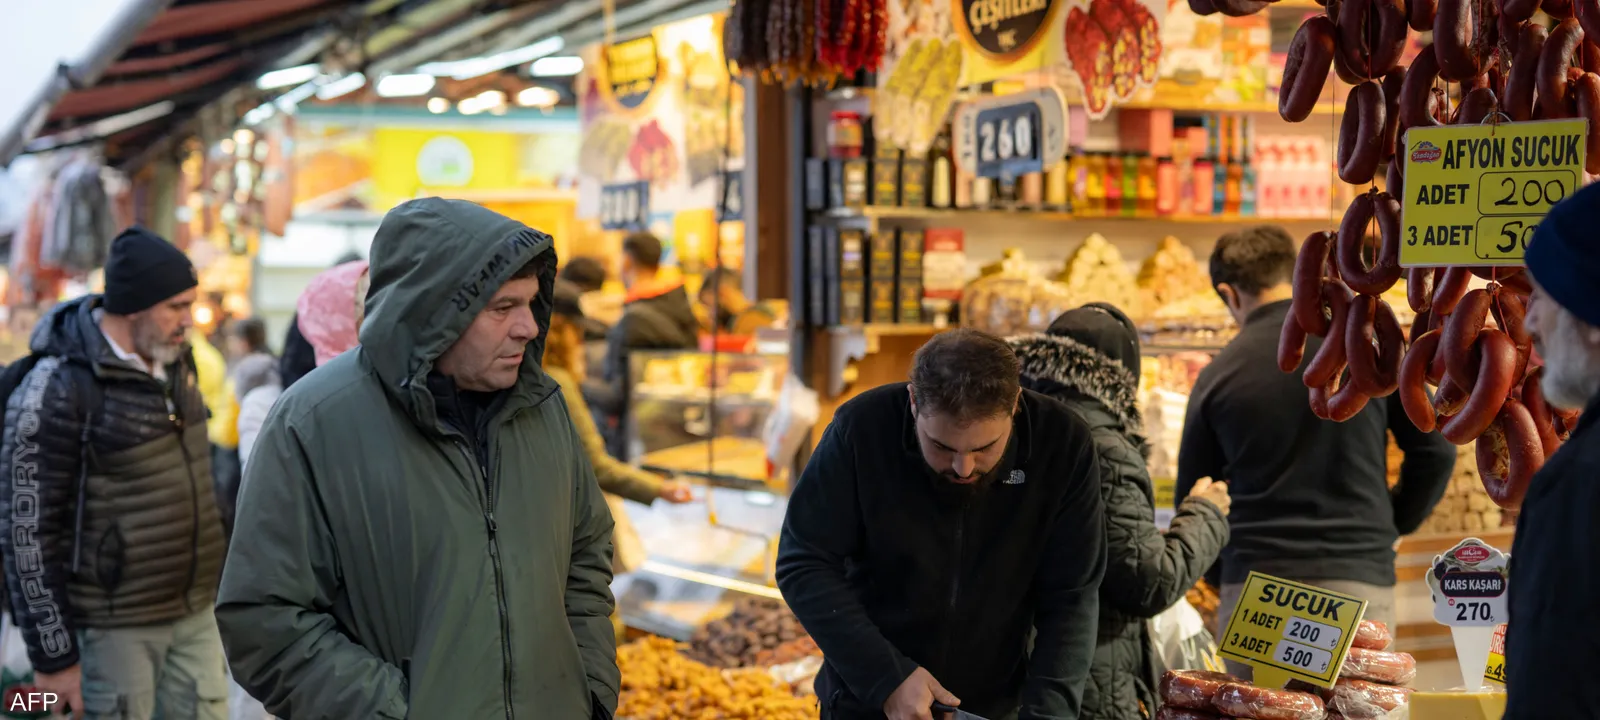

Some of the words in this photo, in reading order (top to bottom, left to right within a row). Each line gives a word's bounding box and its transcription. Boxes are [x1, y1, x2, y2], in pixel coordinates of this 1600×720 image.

[980, 116, 1031, 162] 260
[1442, 138, 1505, 169] AFYON
[1511, 134, 1581, 167] SUCUK
[1416, 184, 1470, 205] ADET
[1494, 177, 1565, 207] 200
[512, 229, 551, 257] NIM
[1407, 225, 1418, 246] 3
[1423, 225, 1473, 246] ADET
[452, 254, 511, 312] WEAR
[1258, 583, 1345, 621] SUCUK
[1444, 579, 1468, 590] KARS
[1469, 579, 1502, 593] KAŞARI
[1242, 608, 1249, 622] 1
[1249, 611, 1282, 630] ADET
[1289, 621, 1320, 643] 200
[1230, 633, 1239, 646] 3
[1239, 634, 1272, 655] ADET
[1282, 646, 1313, 668] 500
